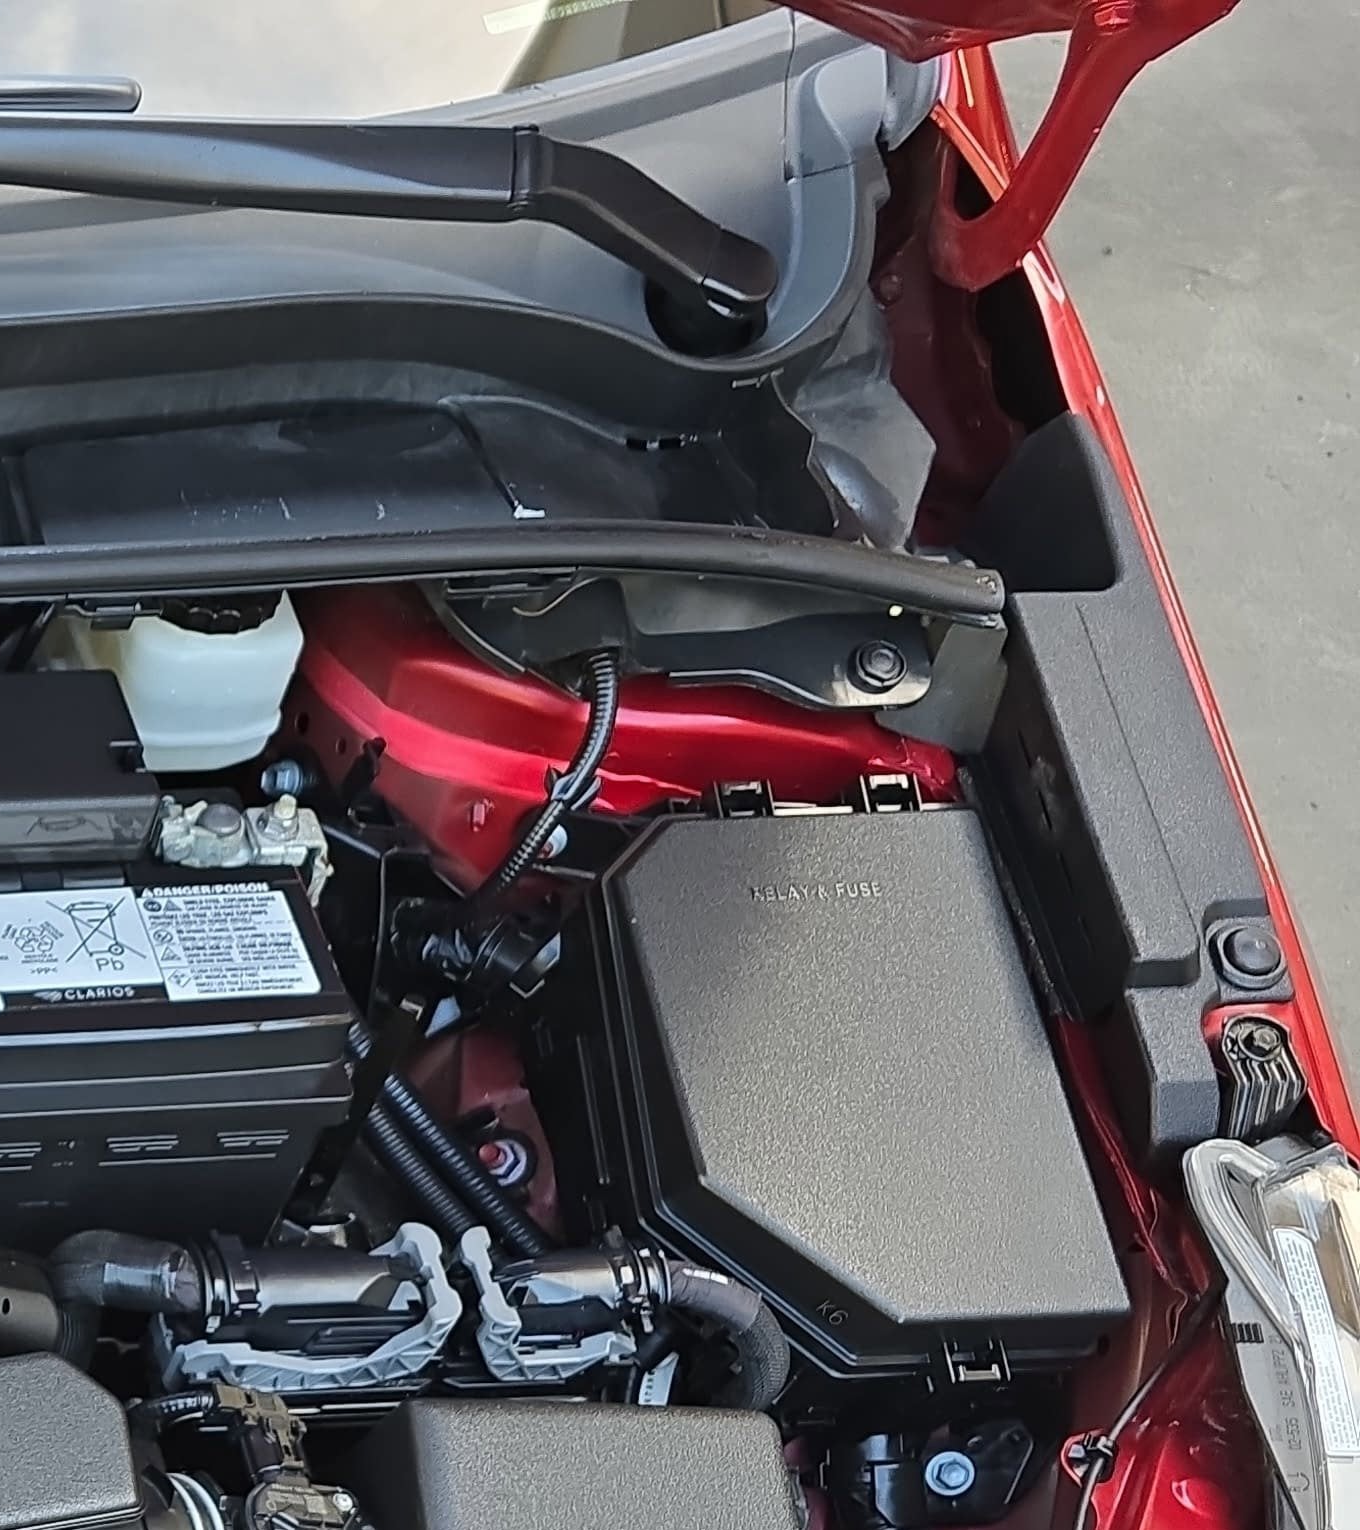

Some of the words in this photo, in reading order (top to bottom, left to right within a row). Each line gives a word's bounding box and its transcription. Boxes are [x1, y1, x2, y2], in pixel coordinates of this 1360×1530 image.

[153, 882, 269, 898] DANGER/POISON
[751, 884, 810, 901] RELAY
[835, 882, 881, 898] FUSE
[96, 956, 125, 972] Pb
[65, 986, 135, 1000] CLARIOS
[816, 1300, 848, 1325] K6
